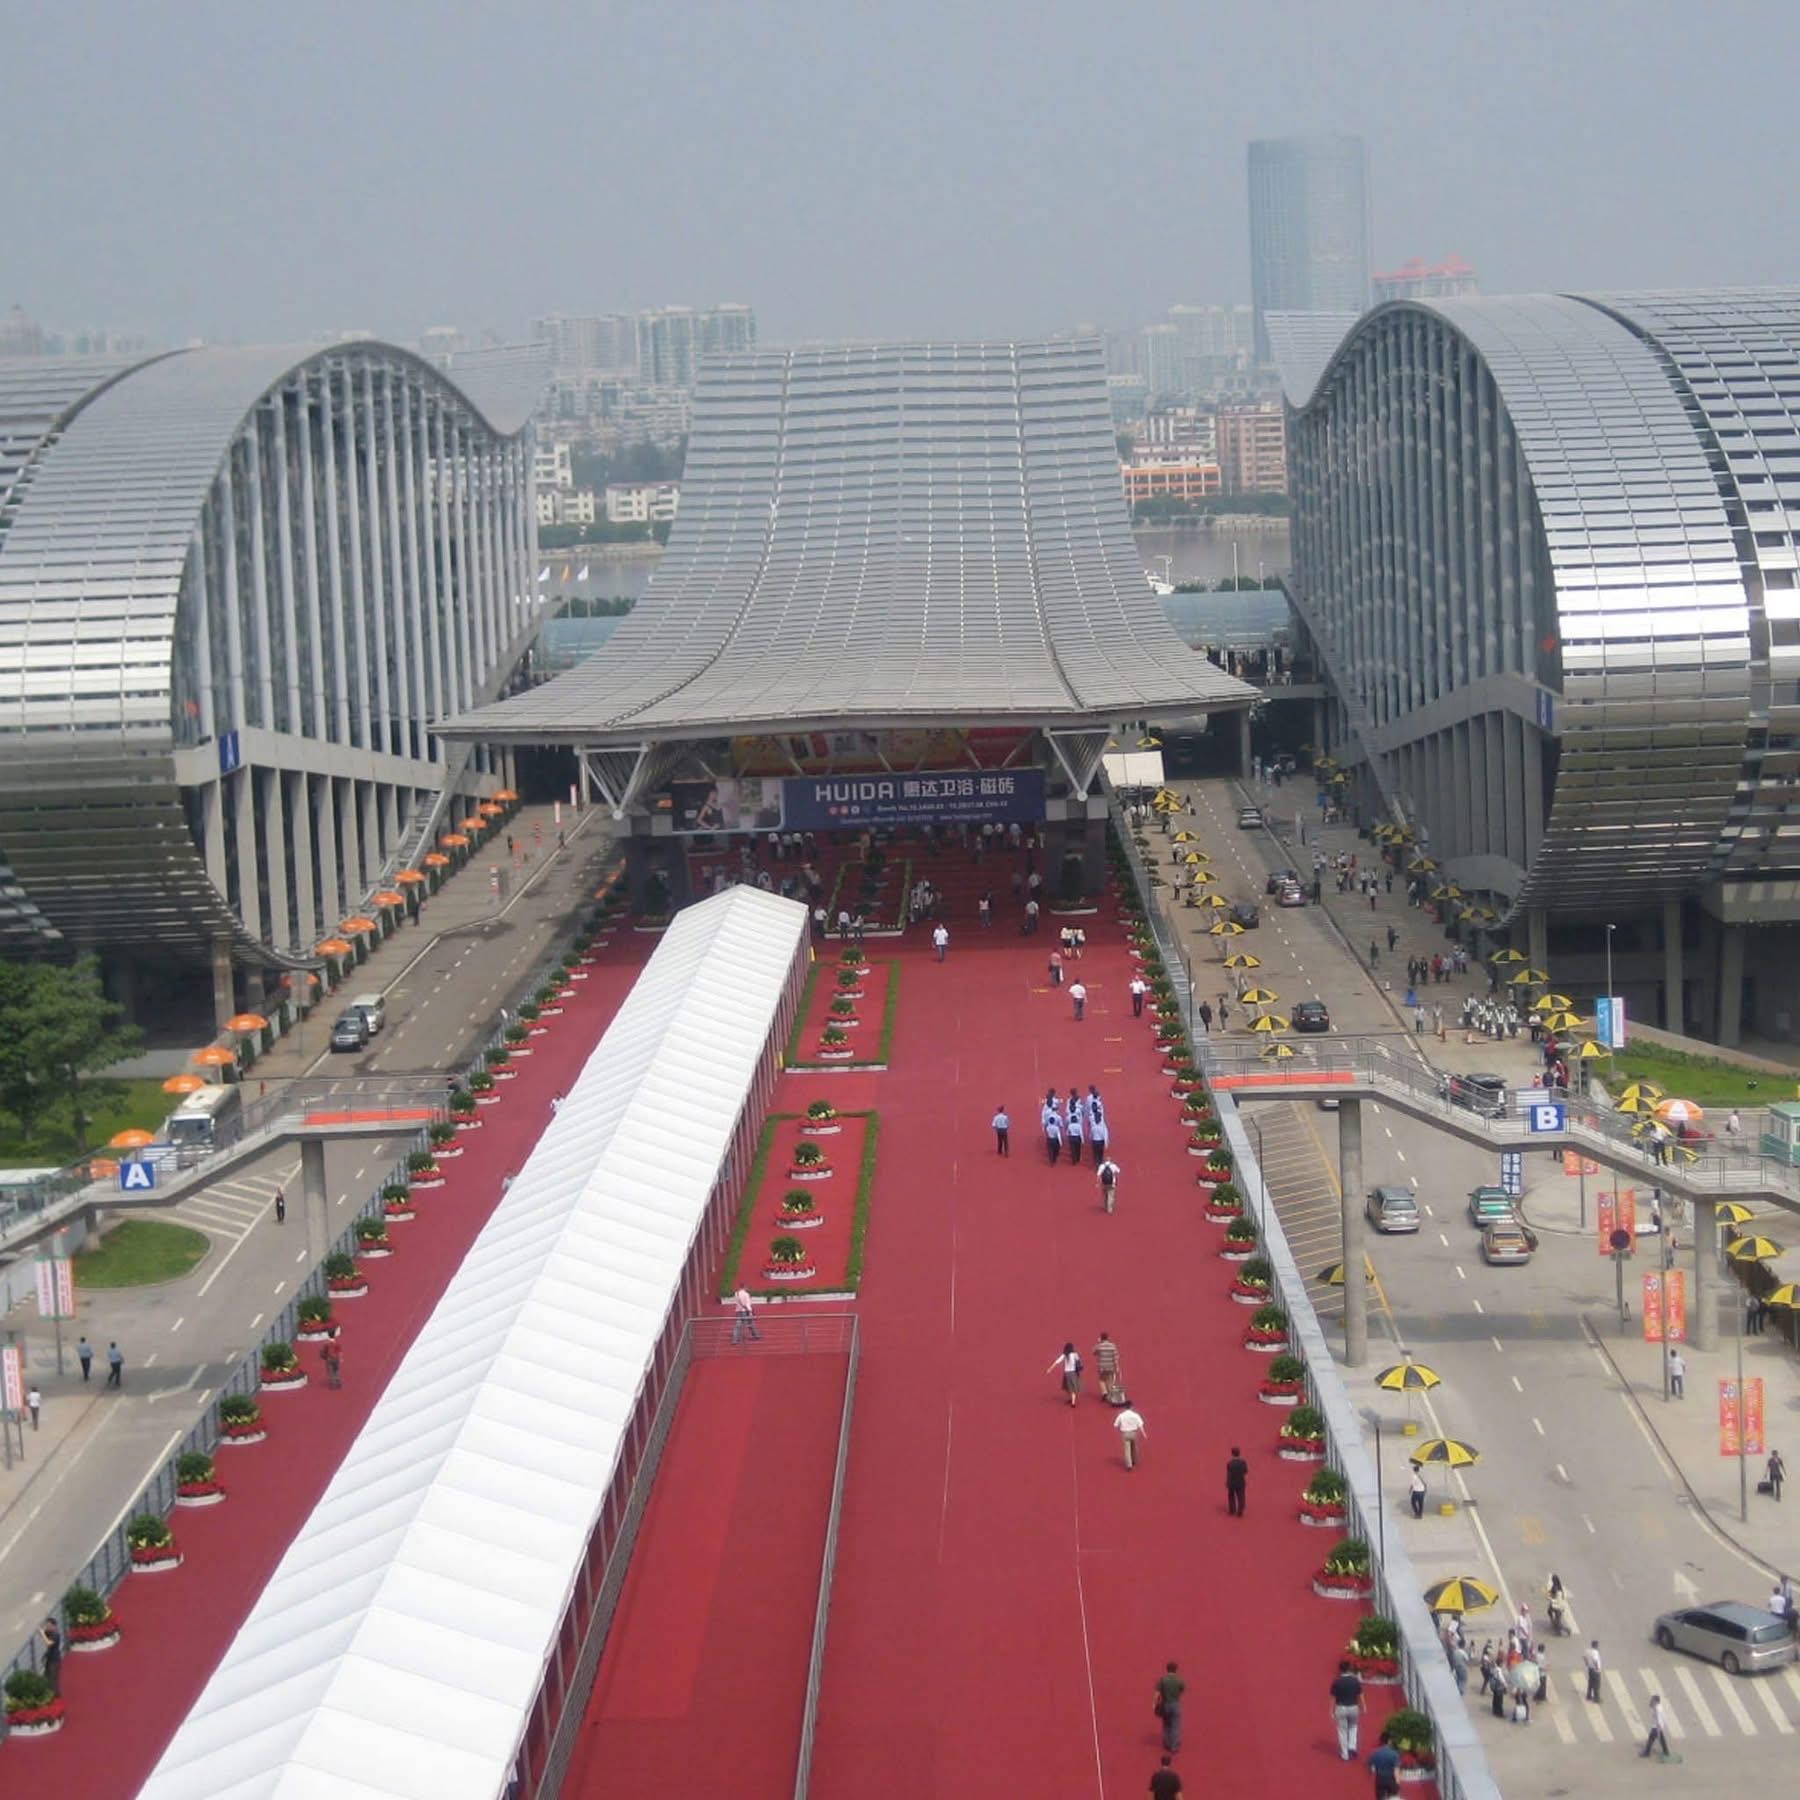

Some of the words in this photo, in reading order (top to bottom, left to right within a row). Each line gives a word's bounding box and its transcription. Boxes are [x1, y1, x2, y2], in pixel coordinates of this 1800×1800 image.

[815, 782, 893, 802] HUIDA
[1536, 1106, 1559, 1130] B
[125, 1163, 151, 1188] A
